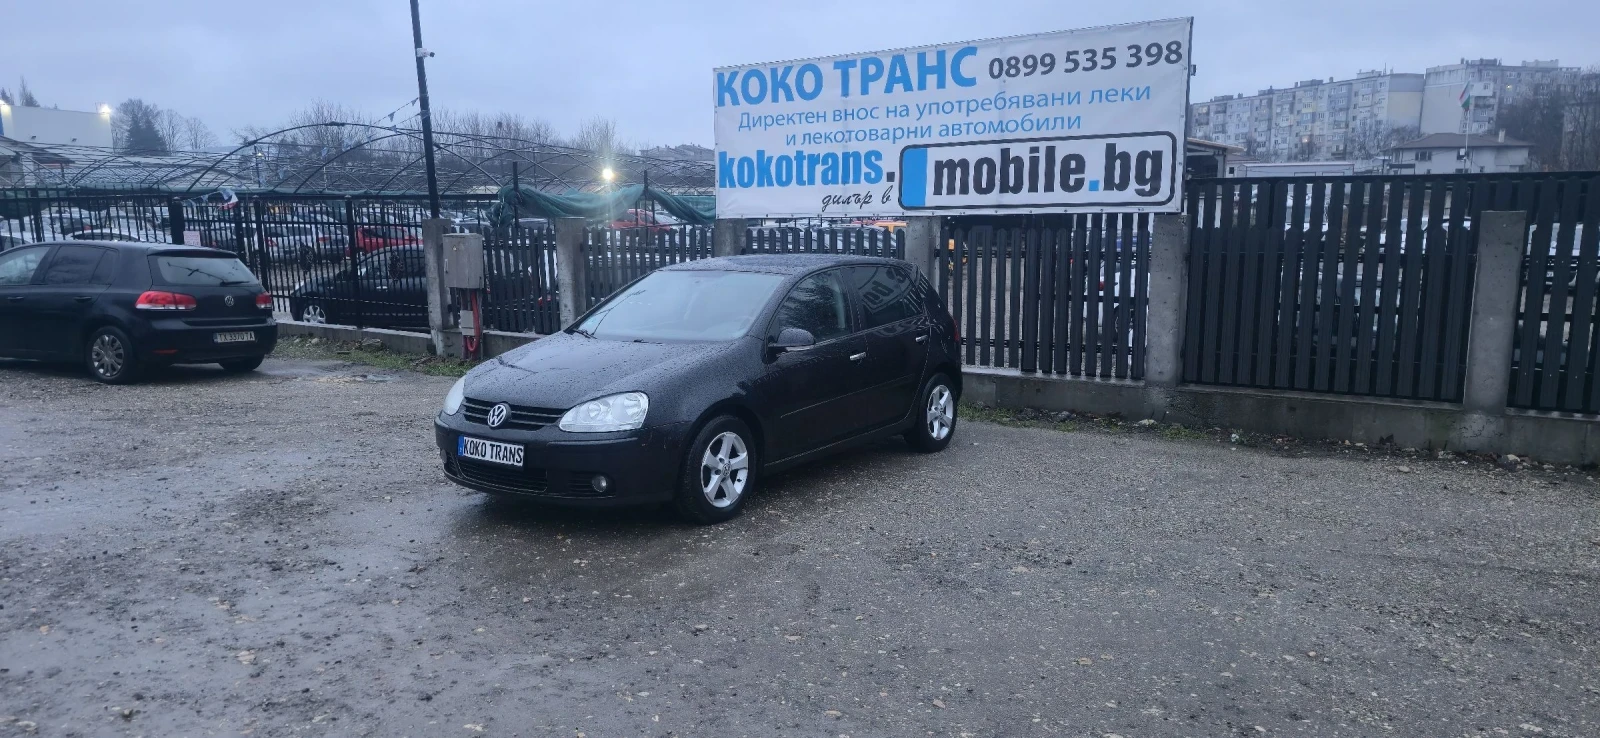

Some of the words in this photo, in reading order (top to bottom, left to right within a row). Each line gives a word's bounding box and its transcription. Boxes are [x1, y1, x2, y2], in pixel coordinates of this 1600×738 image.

[717, 63, 824, 107] КОКО
[833, 46, 978, 97] ТРАНС
[988, 53, 1056, 80] 0899
[1064, 47, 1117, 73] 535
[1126, 40, 1183, 68] 398
[738, 110, 827, 131] Директен
[833, 106, 880, 122] внос
[886, 103, 910, 119] на
[916, 90, 1081, 121] употребявани
[1088, 85, 1151, 104] леки
[786, 134, 796, 146] и
[801, 123, 932, 146] лекотоварни
[938, 113, 1082, 137] автомобили
[932, 142, 1163, 198] mobile.bg
[821, 190, 873, 212] дилър
[463, 438, 487, 458] KOKO
[489, 443, 523, 464] TRANS
